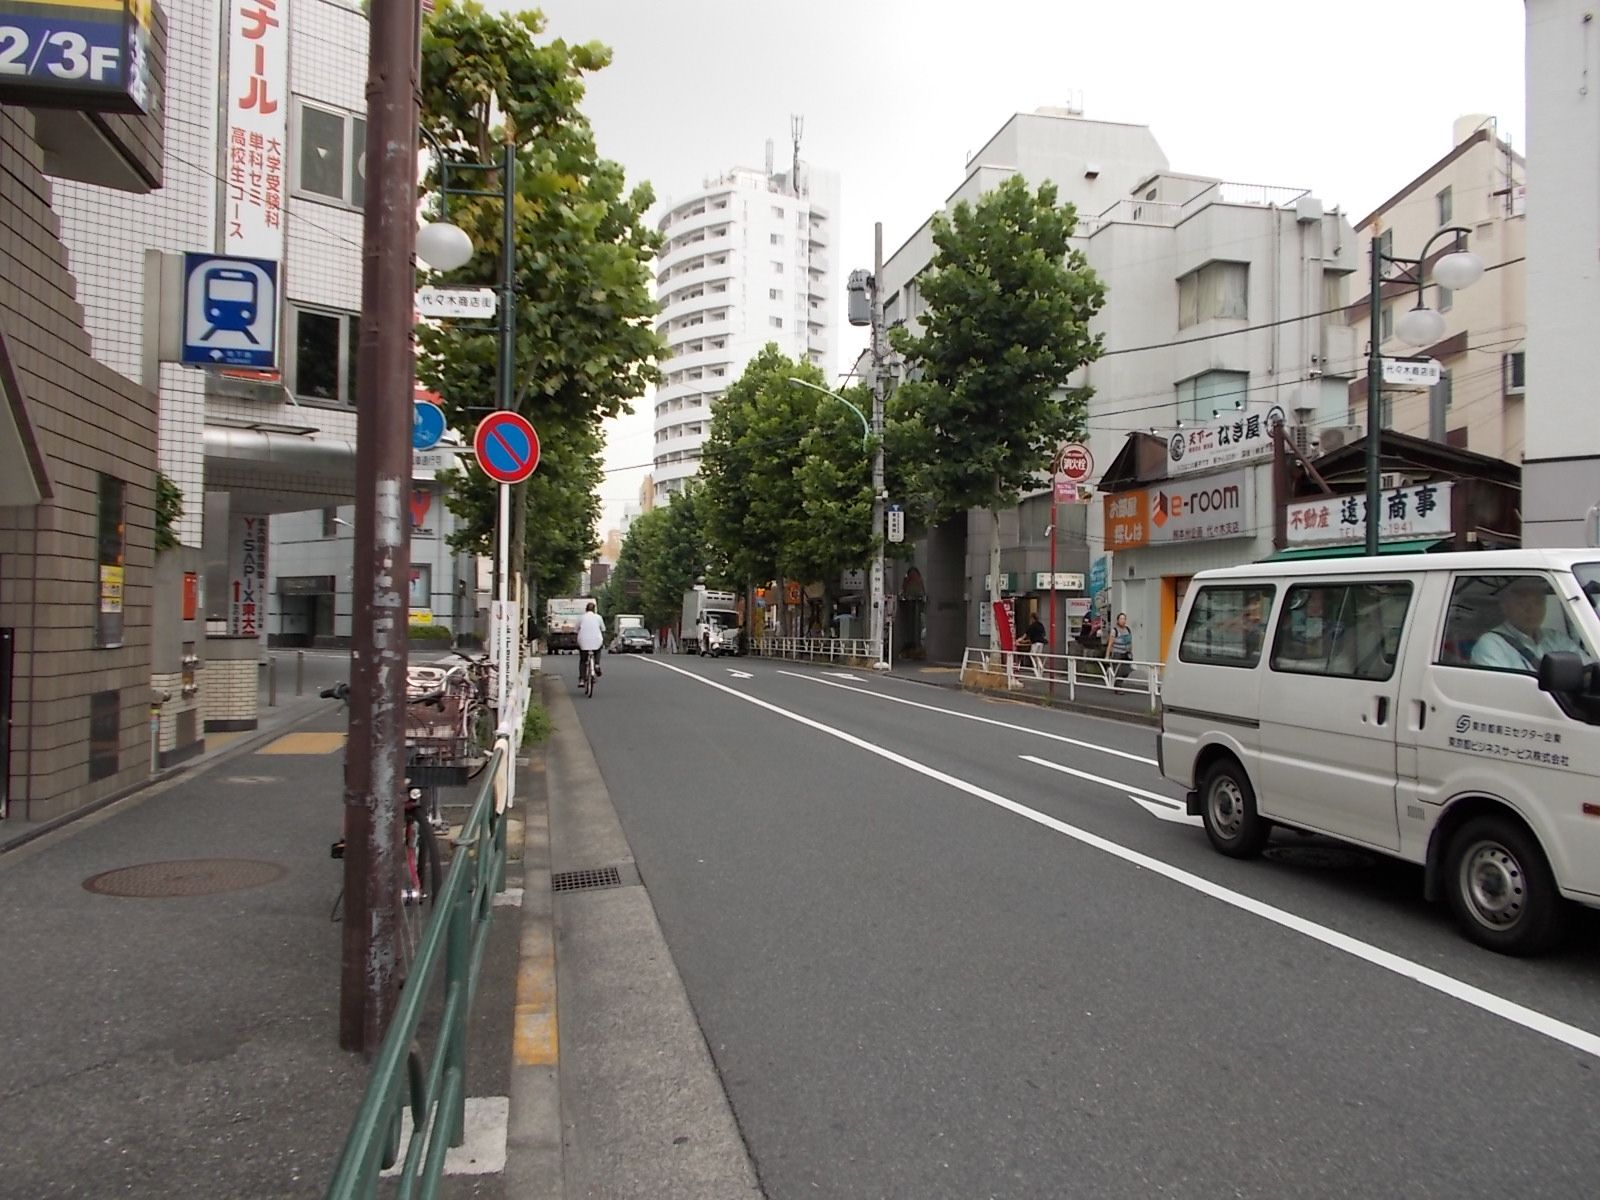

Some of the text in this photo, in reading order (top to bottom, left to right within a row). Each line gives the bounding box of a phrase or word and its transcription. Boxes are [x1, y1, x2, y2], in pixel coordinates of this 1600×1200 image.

[0, 26, 119, 81] 2/3F
[229, 127, 246, 239] 高校生コース
[264, 138, 281, 229] 大学受験科
[1217, 414, 1260, 446] なぎ屋
[1063, 458, 1086, 470] 消火栓
[1109, 497, 1137, 519] お部屋
[1171, 485, 1239, 517] e-room
[1289, 484, 1438, 530] 不動産 遠商事
[242, 517, 256, 635] Y-SAPIX東大
[1448, 736, 1569, 767] 東京都ビジネスサービス株式会社
